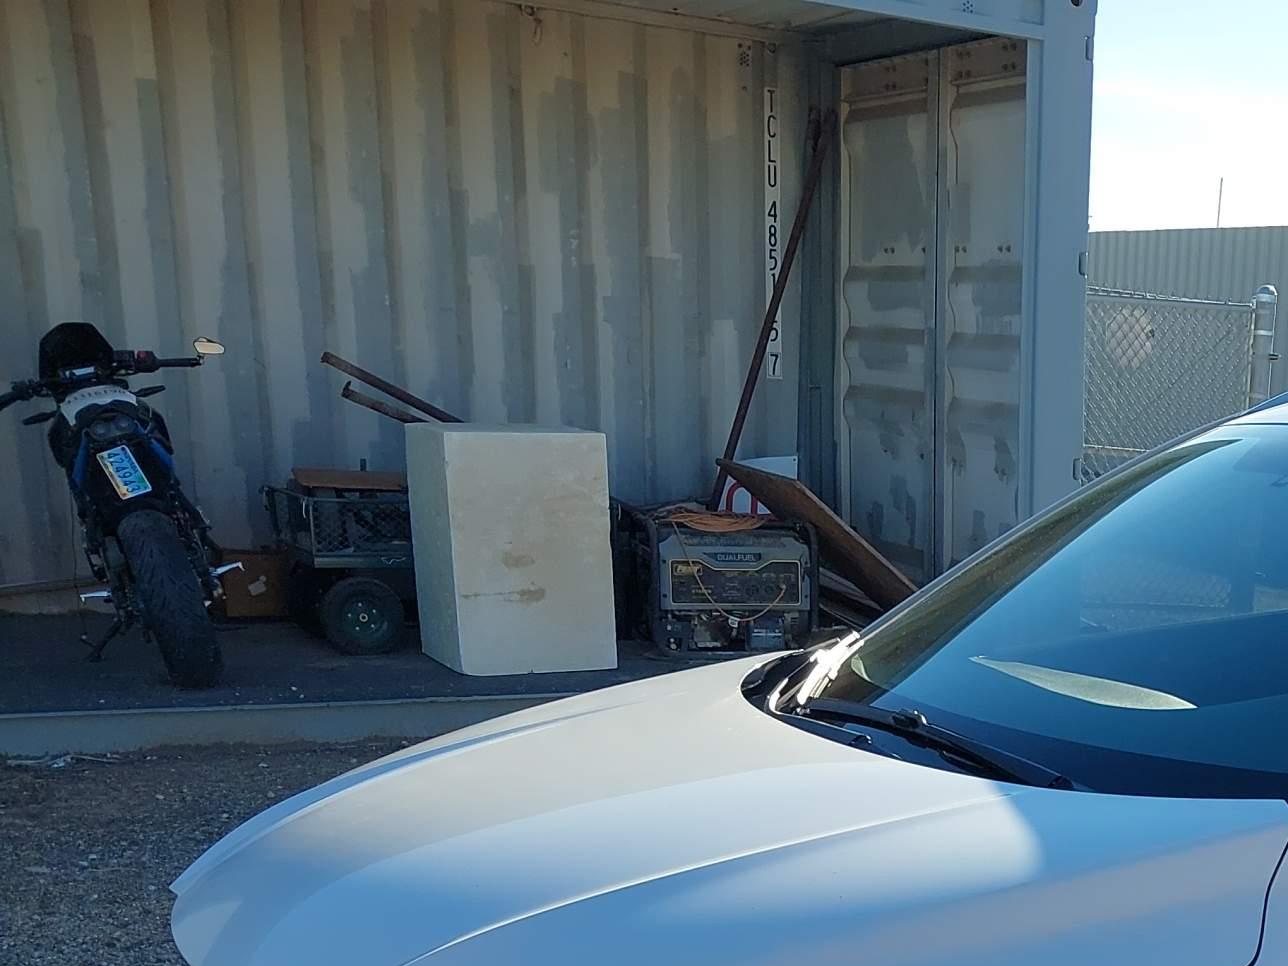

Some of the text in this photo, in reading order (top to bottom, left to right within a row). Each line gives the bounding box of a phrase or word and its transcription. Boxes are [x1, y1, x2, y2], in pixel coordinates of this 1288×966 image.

[767, 89, 779, 376] TCLU 48515 7
[107, 452, 141, 493] 424943
